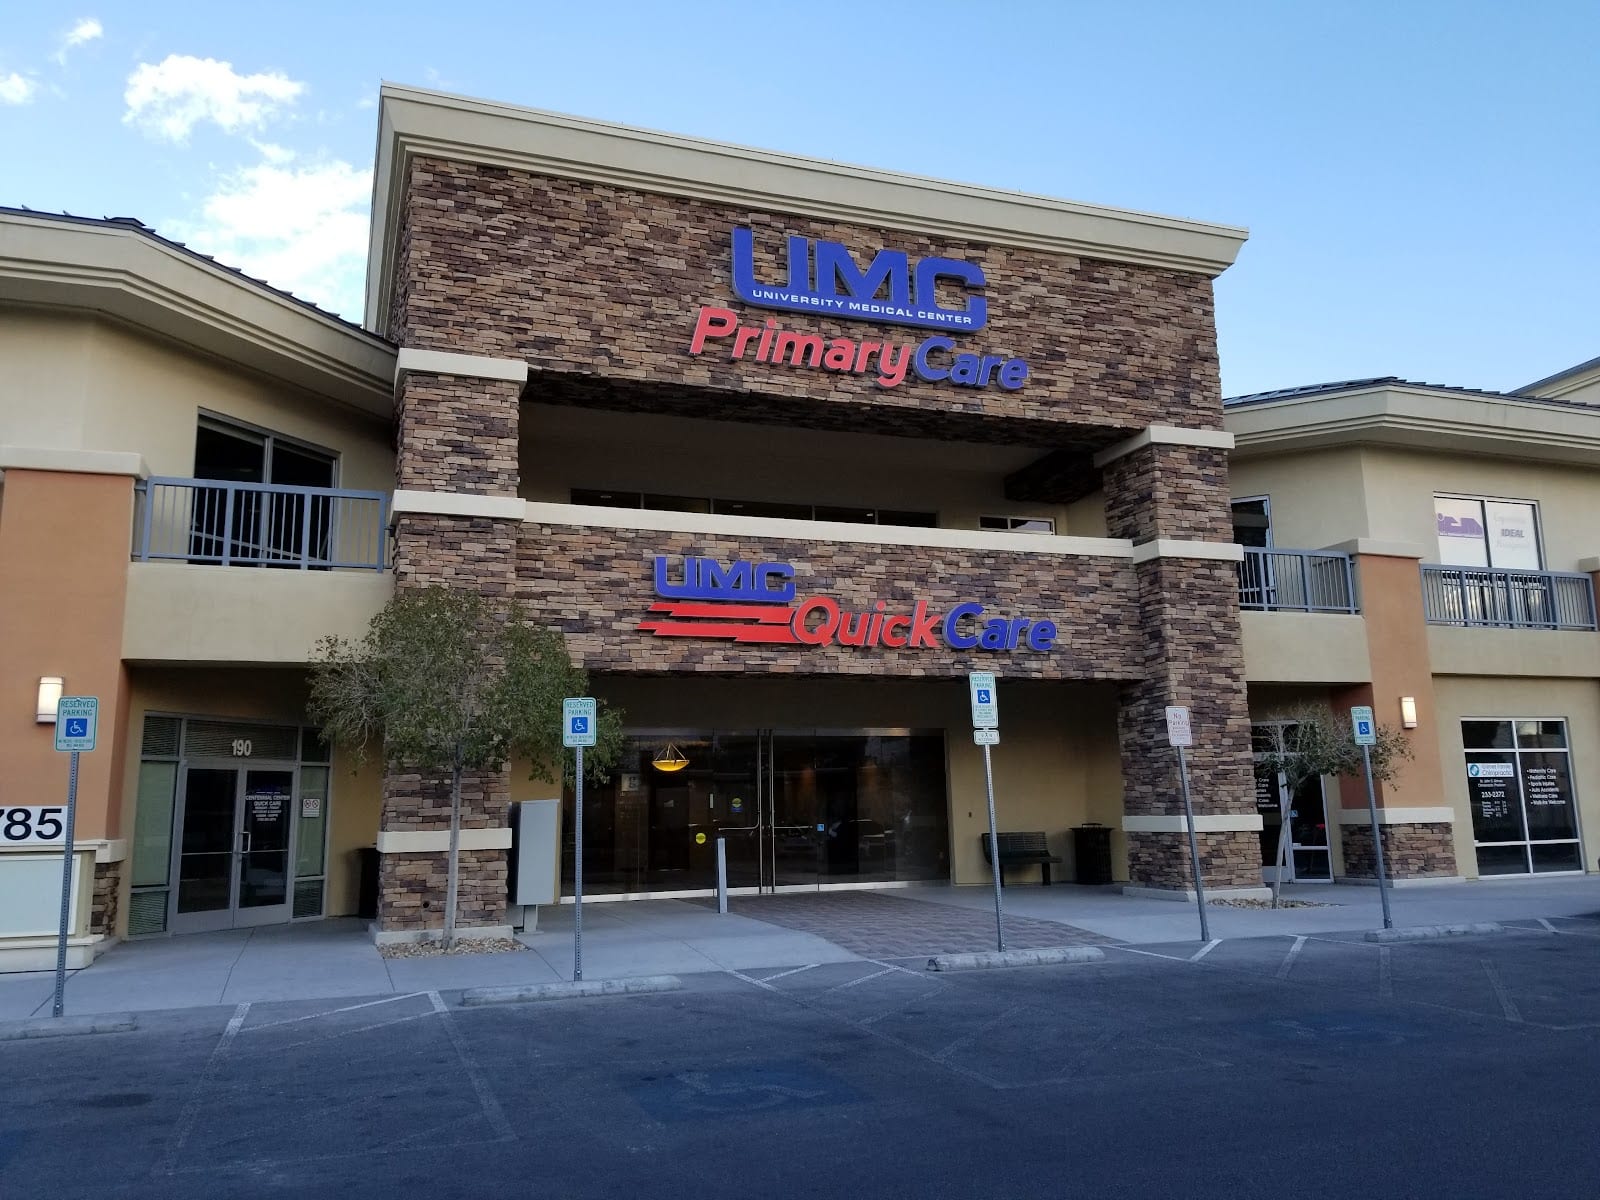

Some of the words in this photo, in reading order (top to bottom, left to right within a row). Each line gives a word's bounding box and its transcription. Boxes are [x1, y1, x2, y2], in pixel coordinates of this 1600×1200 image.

[731, 226, 988, 333] UMC
[752, 289, 844, 309] UNIVERSITY
[848, 302, 913, 318] MEDICAL
[917, 310, 973, 326] CENTER
[1501, 528, 1525, 538] IDEAL
[653, 556, 797, 601] UMC
[61, 700, 95, 708] RESERVED
[232, 739, 252, 756] 190
[0, 808, 63, 841] 85
